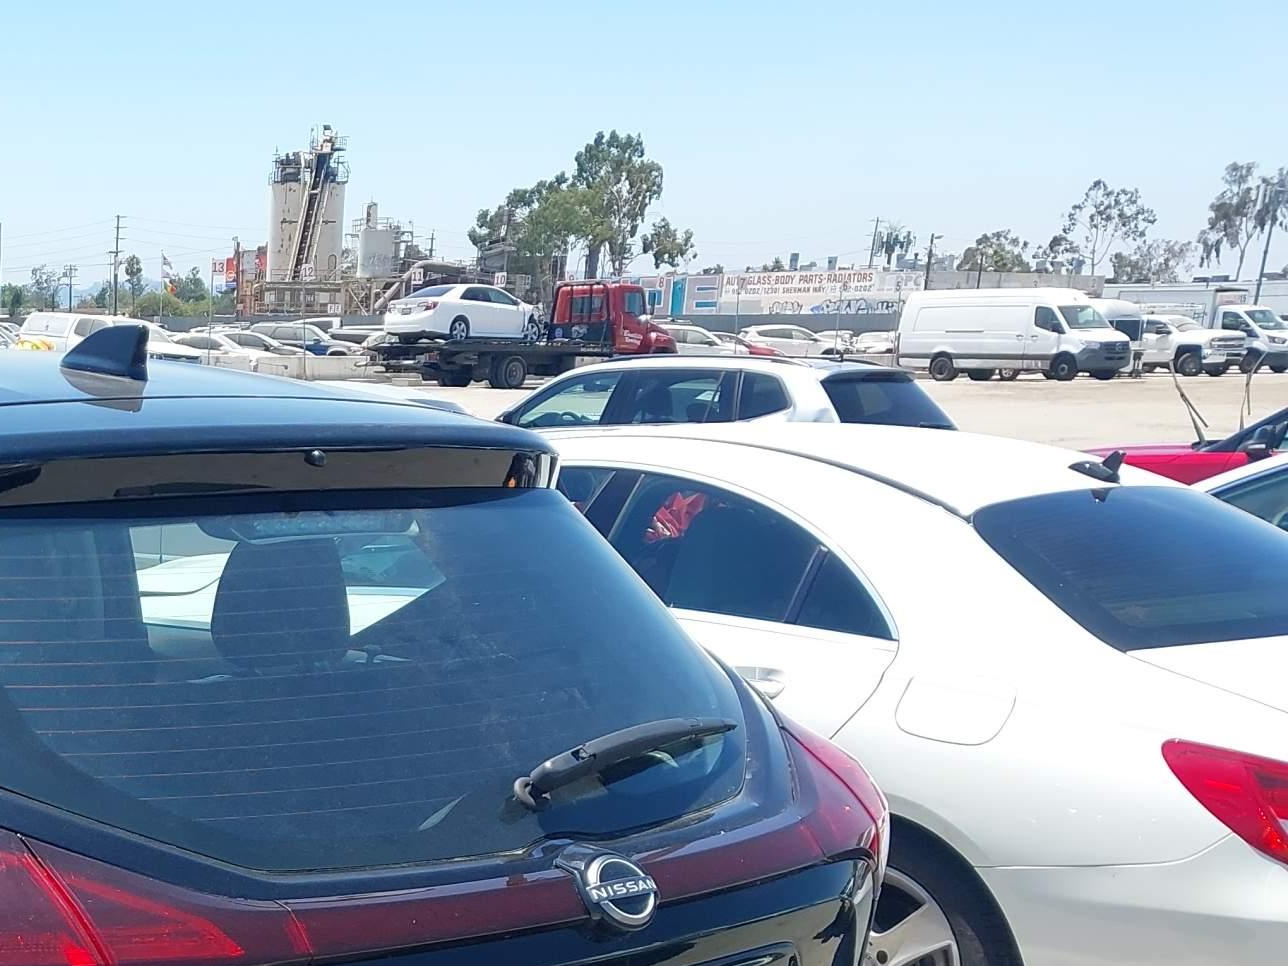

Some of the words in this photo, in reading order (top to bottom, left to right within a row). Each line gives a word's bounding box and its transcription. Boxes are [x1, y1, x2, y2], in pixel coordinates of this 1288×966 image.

[212, 261, 225, 272] 13
[302, 266, 313, 277] 12
[412, 271, 422, 280] 11
[495, 275, 505, 284] 10
[592, 879, 657, 900] NISSAN
